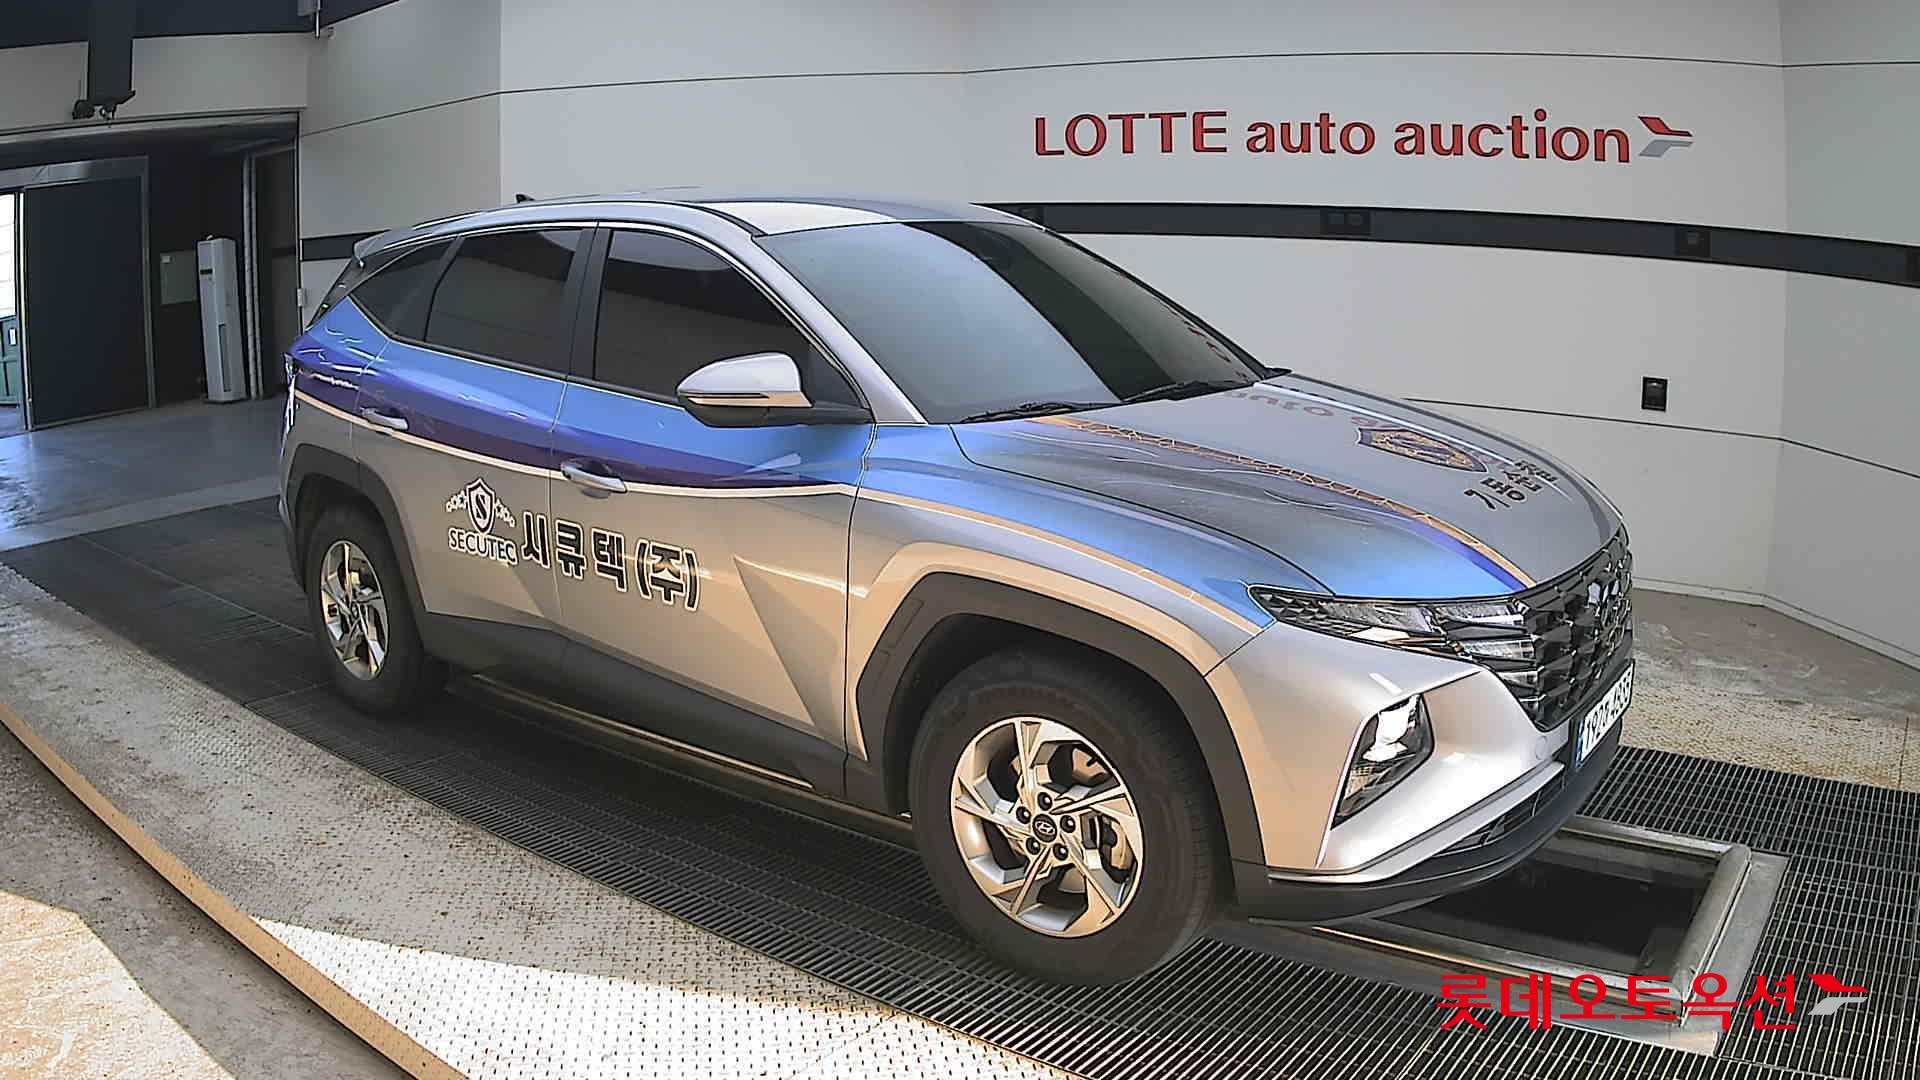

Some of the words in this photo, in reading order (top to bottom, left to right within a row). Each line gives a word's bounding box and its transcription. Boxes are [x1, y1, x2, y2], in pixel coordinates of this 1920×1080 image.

[1034, 111, 1228, 157] LOTTE
[1246, 112, 1376, 155] auto
[1392, 108, 1631, 164] auction
[448, 527, 518, 565] SECUTEC
